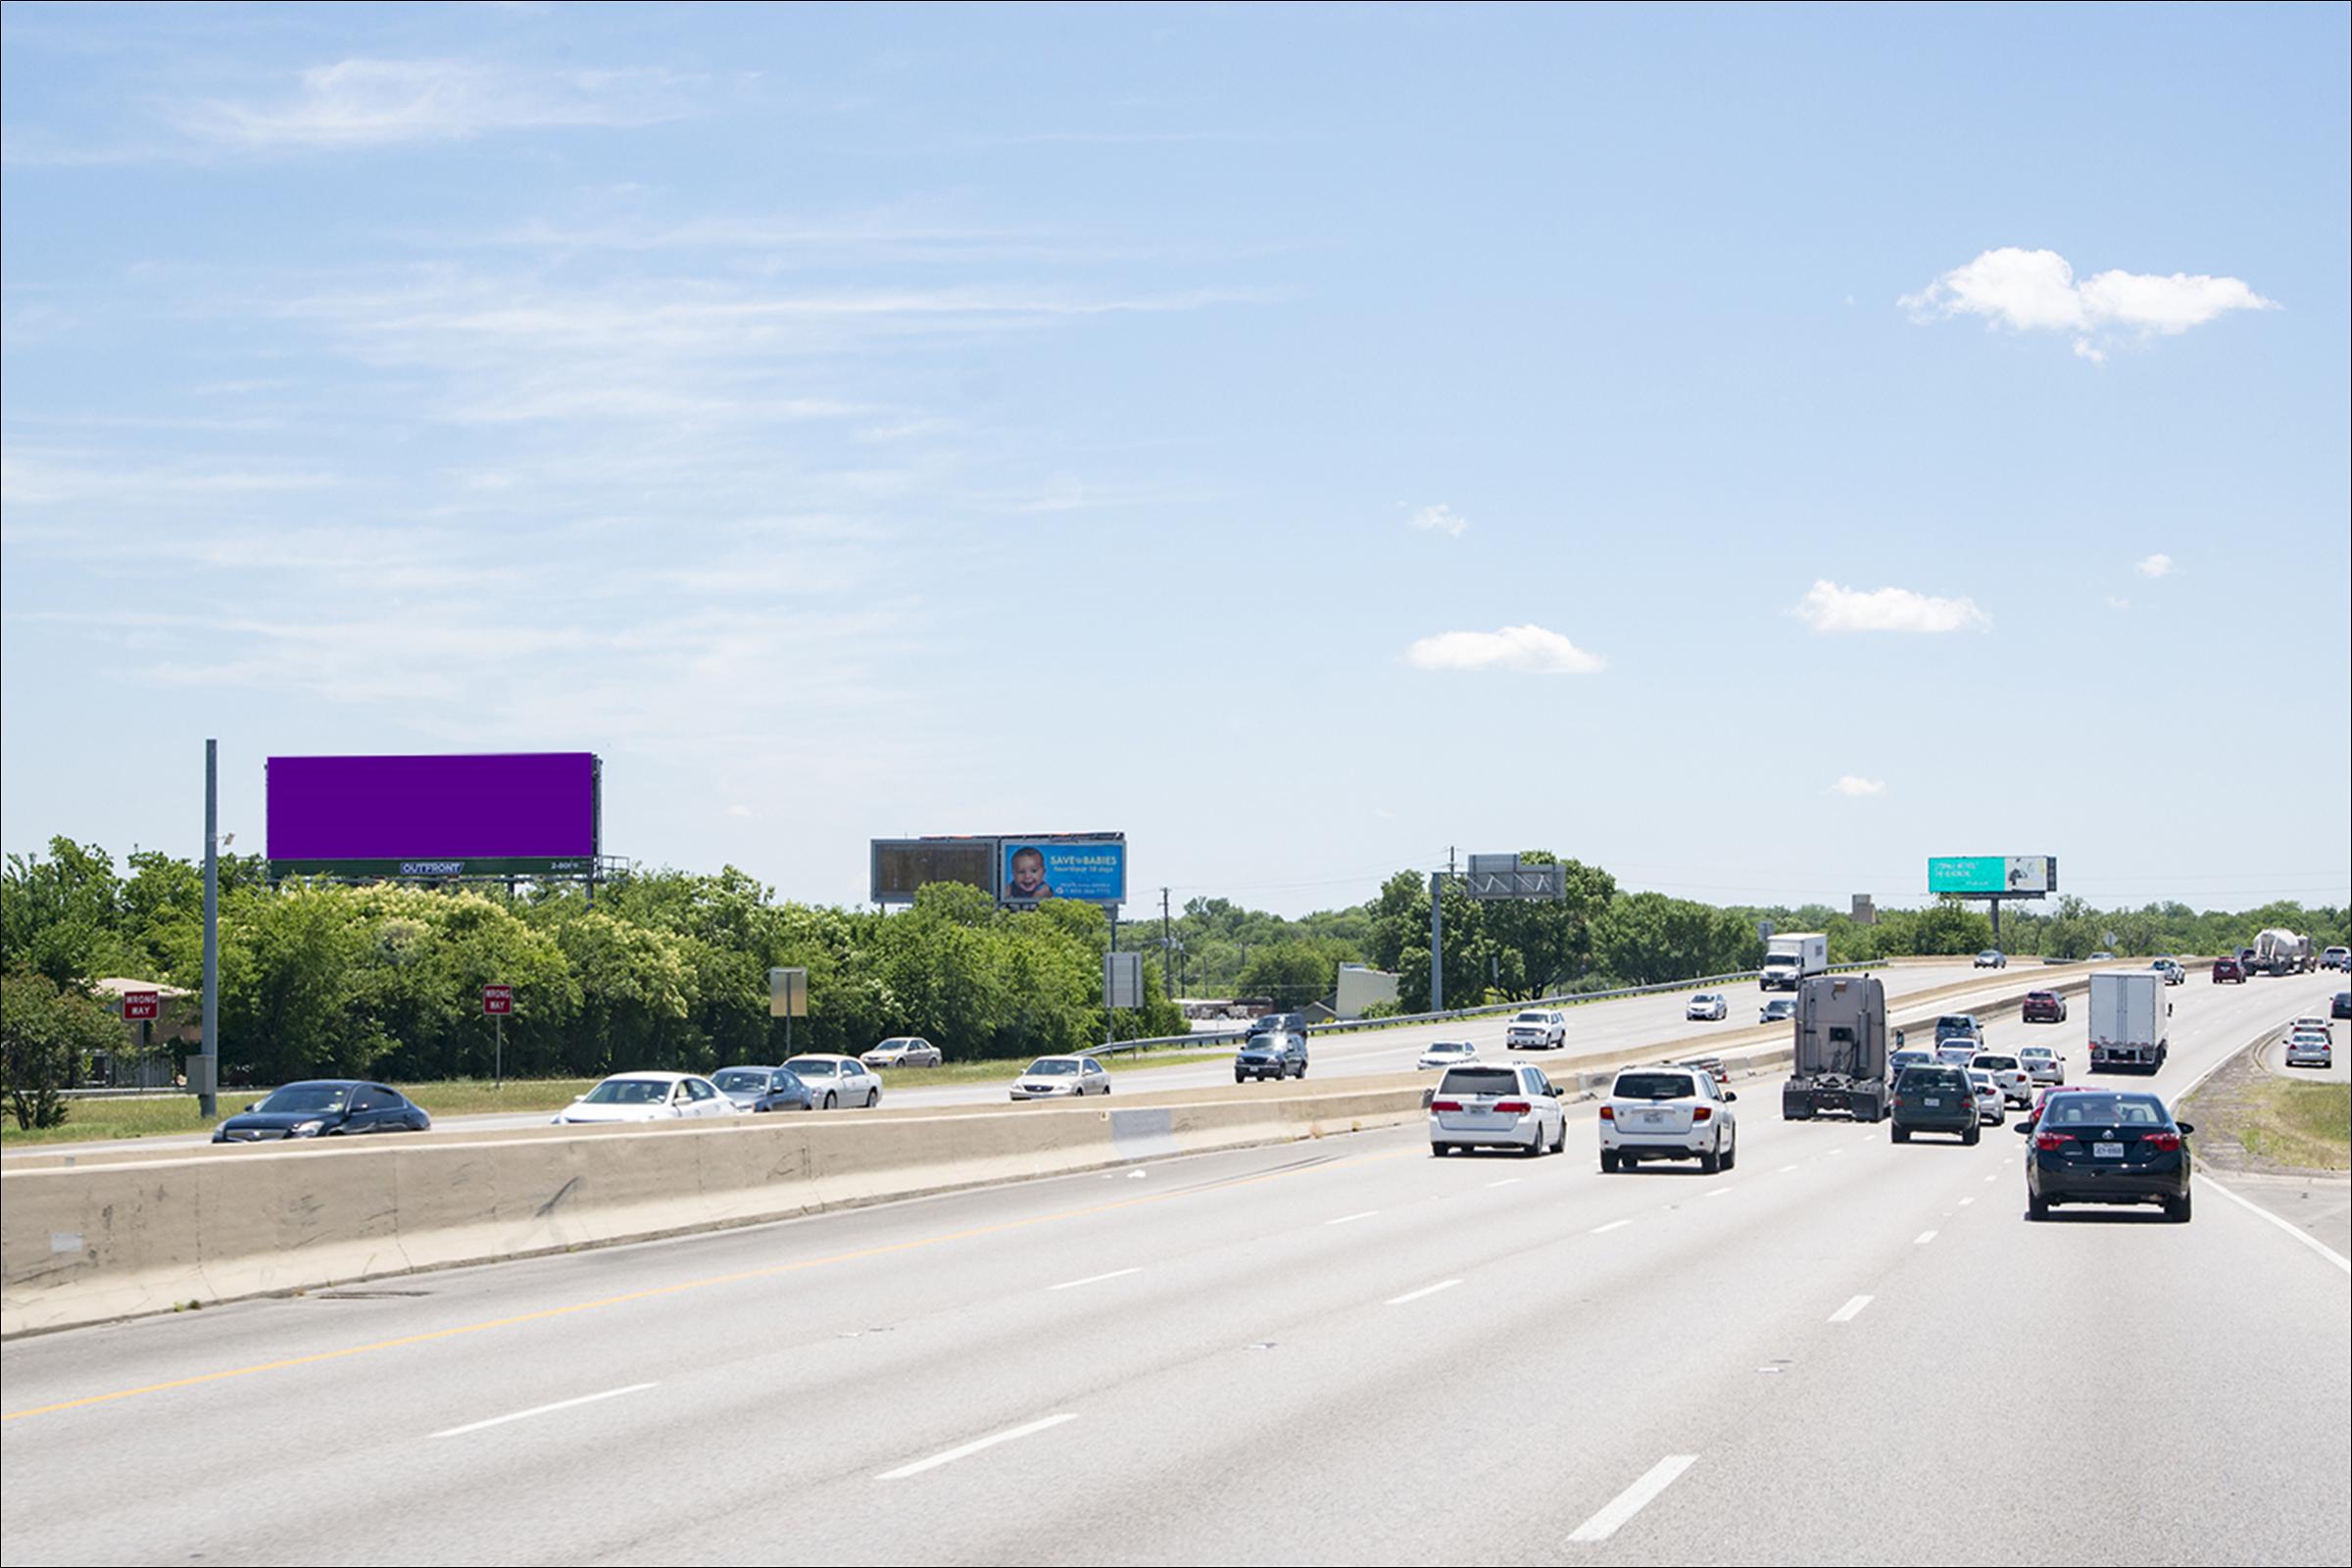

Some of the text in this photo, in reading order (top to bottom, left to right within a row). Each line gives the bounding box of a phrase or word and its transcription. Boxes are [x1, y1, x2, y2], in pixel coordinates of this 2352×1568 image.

[1051, 856, 1117, 865] SAVE BABIES
[402, 862, 462, 873] OUTFRONT
[486, 989, 510, 999] WRONG
[126, 995, 157, 1004] WRONG
[490, 1001, 506, 1009] WAY
[131, 1005, 151, 1015] WAY
